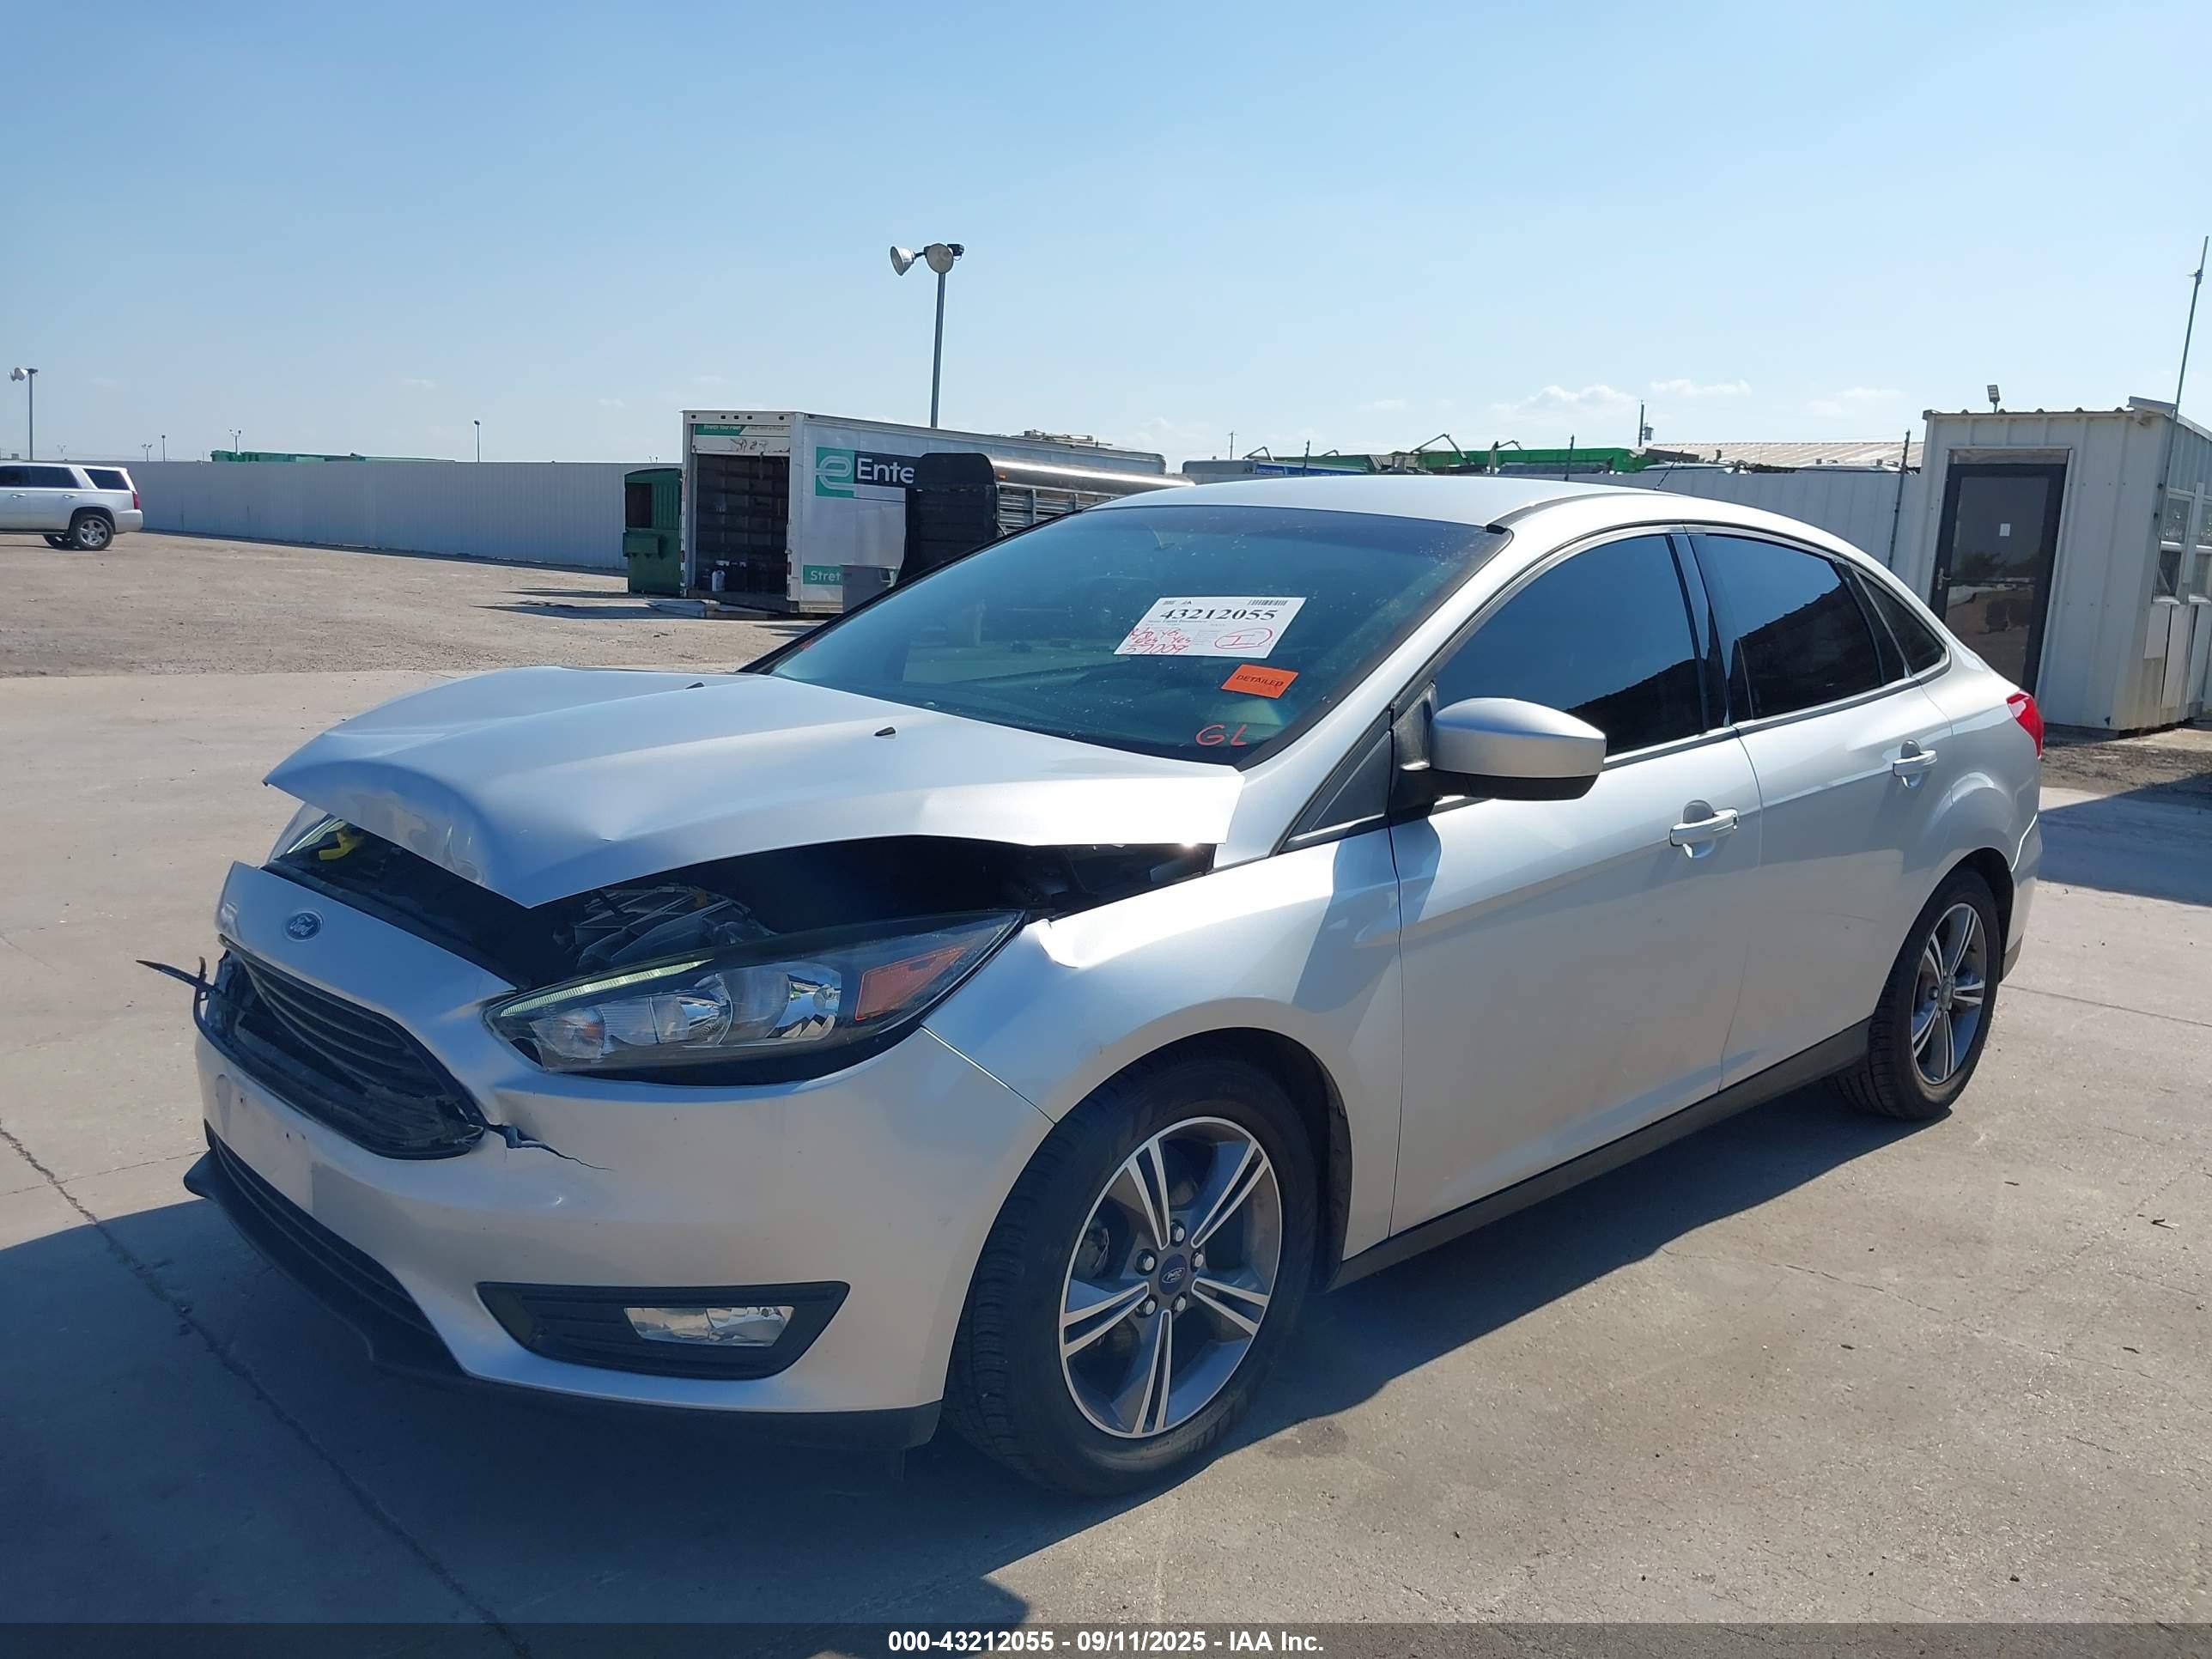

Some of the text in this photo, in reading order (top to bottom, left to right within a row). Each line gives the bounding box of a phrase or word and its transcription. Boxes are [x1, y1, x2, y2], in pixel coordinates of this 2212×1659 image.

[810, 570, 842, 581] Stret
[1159, 608, 1278, 620] 43212055
[1235, 674, 1284, 688] DETAILED
